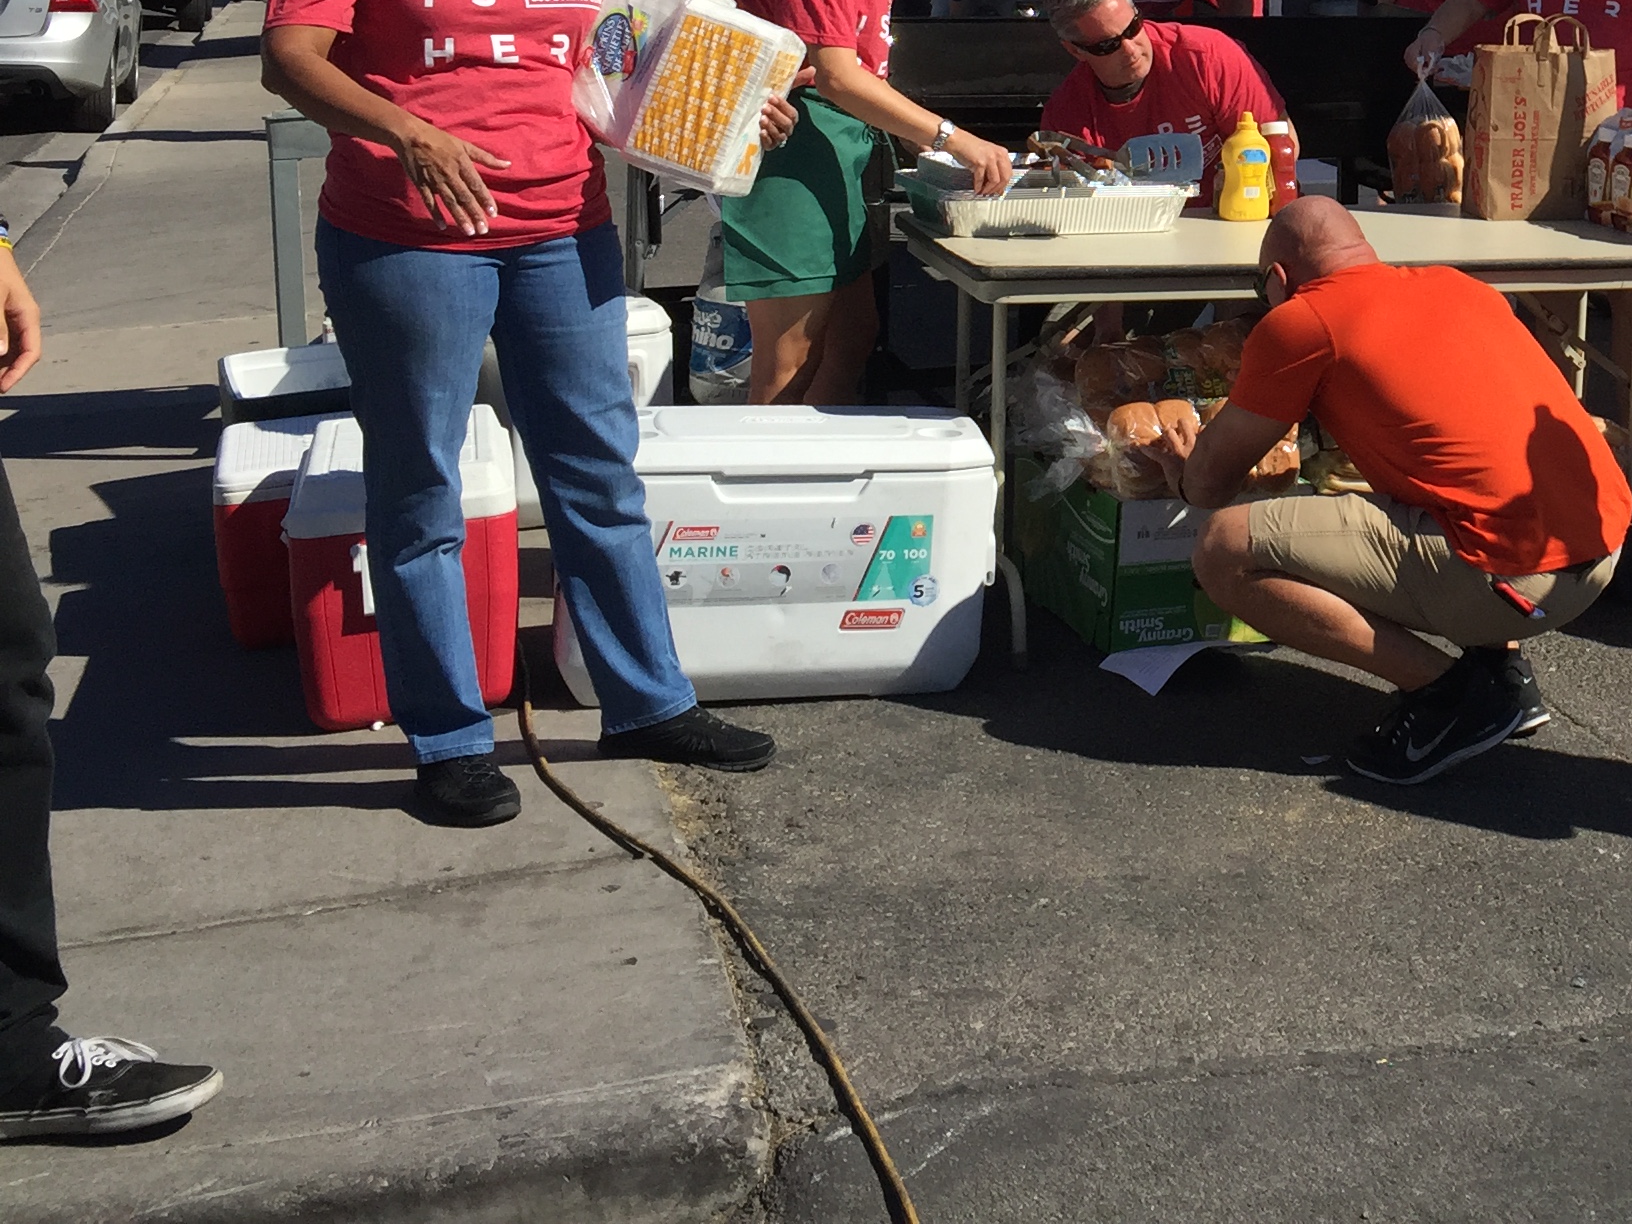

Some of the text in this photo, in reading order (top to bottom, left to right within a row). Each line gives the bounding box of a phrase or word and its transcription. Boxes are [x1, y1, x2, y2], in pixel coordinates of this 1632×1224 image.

[1511, 95, 1527, 211] TRADER JOE'S
[677, 528, 710, 537] Coleman
[669, 545, 739, 559] MARINE
[879, 549, 928, 561] 70 100
[913, 584, 925, 599] 5
[845, 612, 889, 626] Coleman
[1119, 616, 1165, 634] Smith
[1137, 626, 1194, 643] Granny
